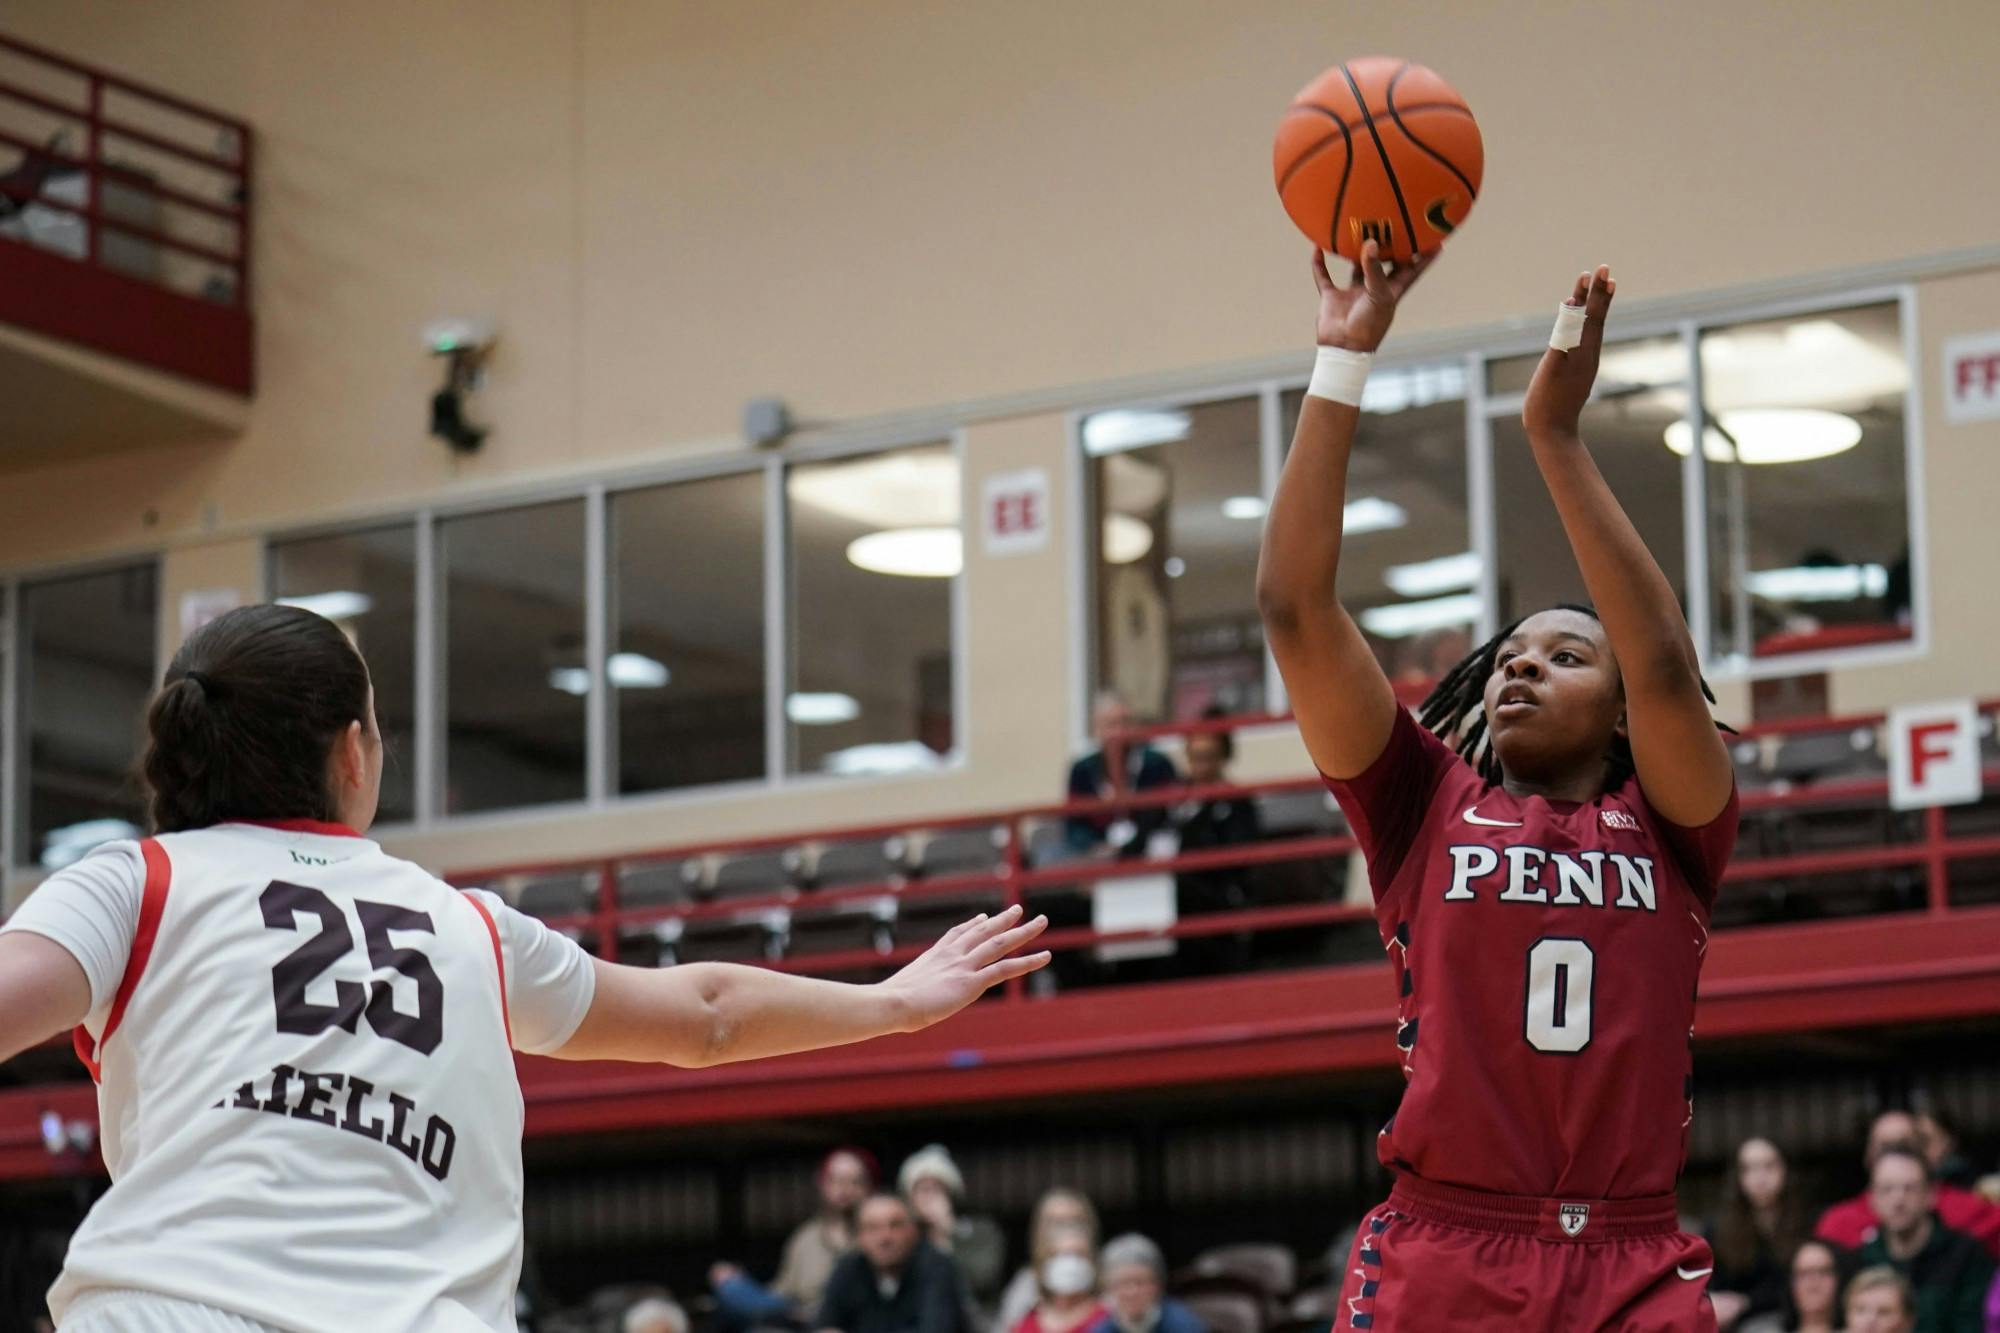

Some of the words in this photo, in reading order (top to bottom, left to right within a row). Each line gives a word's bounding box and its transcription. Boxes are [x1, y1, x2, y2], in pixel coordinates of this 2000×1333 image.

[993, 492, 1043, 537] EE
[1909, 722, 1957, 786] F
[1444, 845, 1657, 912] PENN
[258, 879, 444, 1057] 25
[1526, 937, 1594, 1054] 0
[1569, 1215, 1580, 1230] P
